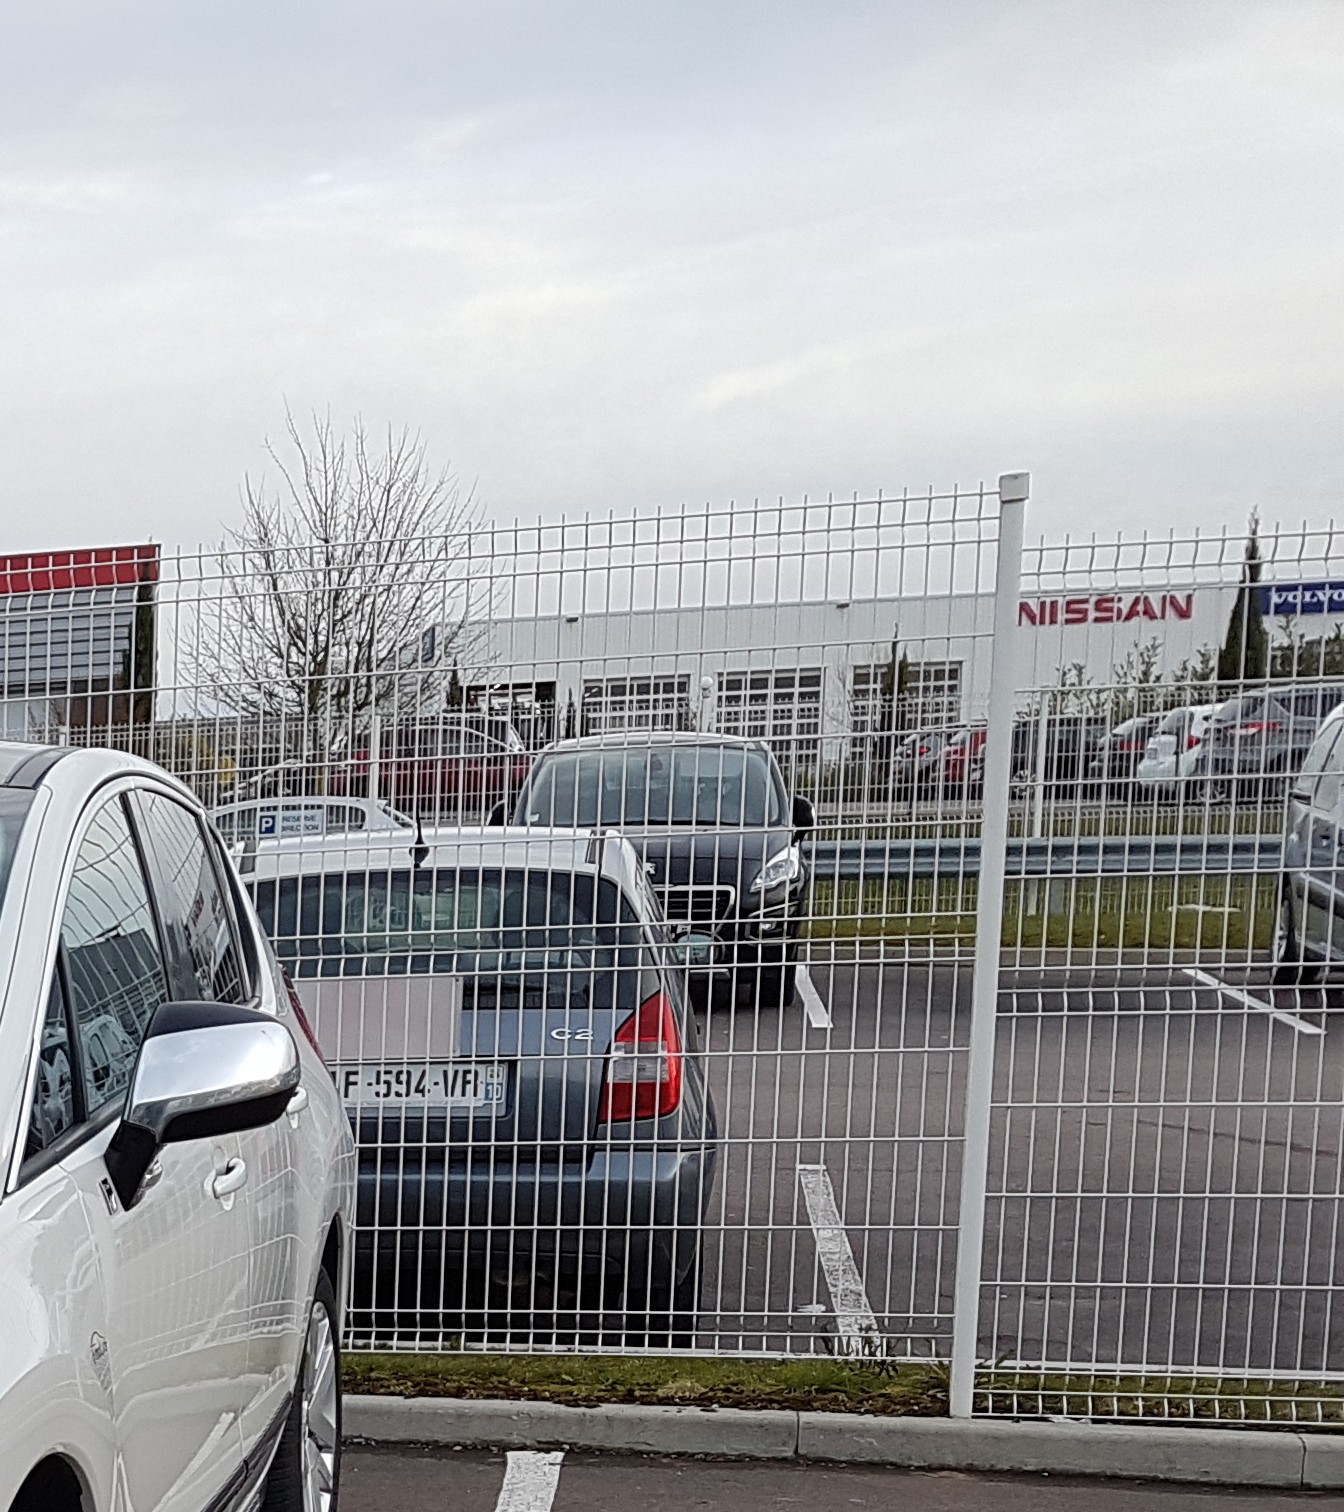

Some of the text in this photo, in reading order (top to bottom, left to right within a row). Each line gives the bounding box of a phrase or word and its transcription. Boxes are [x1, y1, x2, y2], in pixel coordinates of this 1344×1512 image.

[1018, 593, 1194, 627] NISSAN
[261, 817, 273, 833] P
[550, 1027, 594, 1040] C2
[331, 1069, 480, 1099] F-594-VR
[486, 1084, 502, 1099] 10
